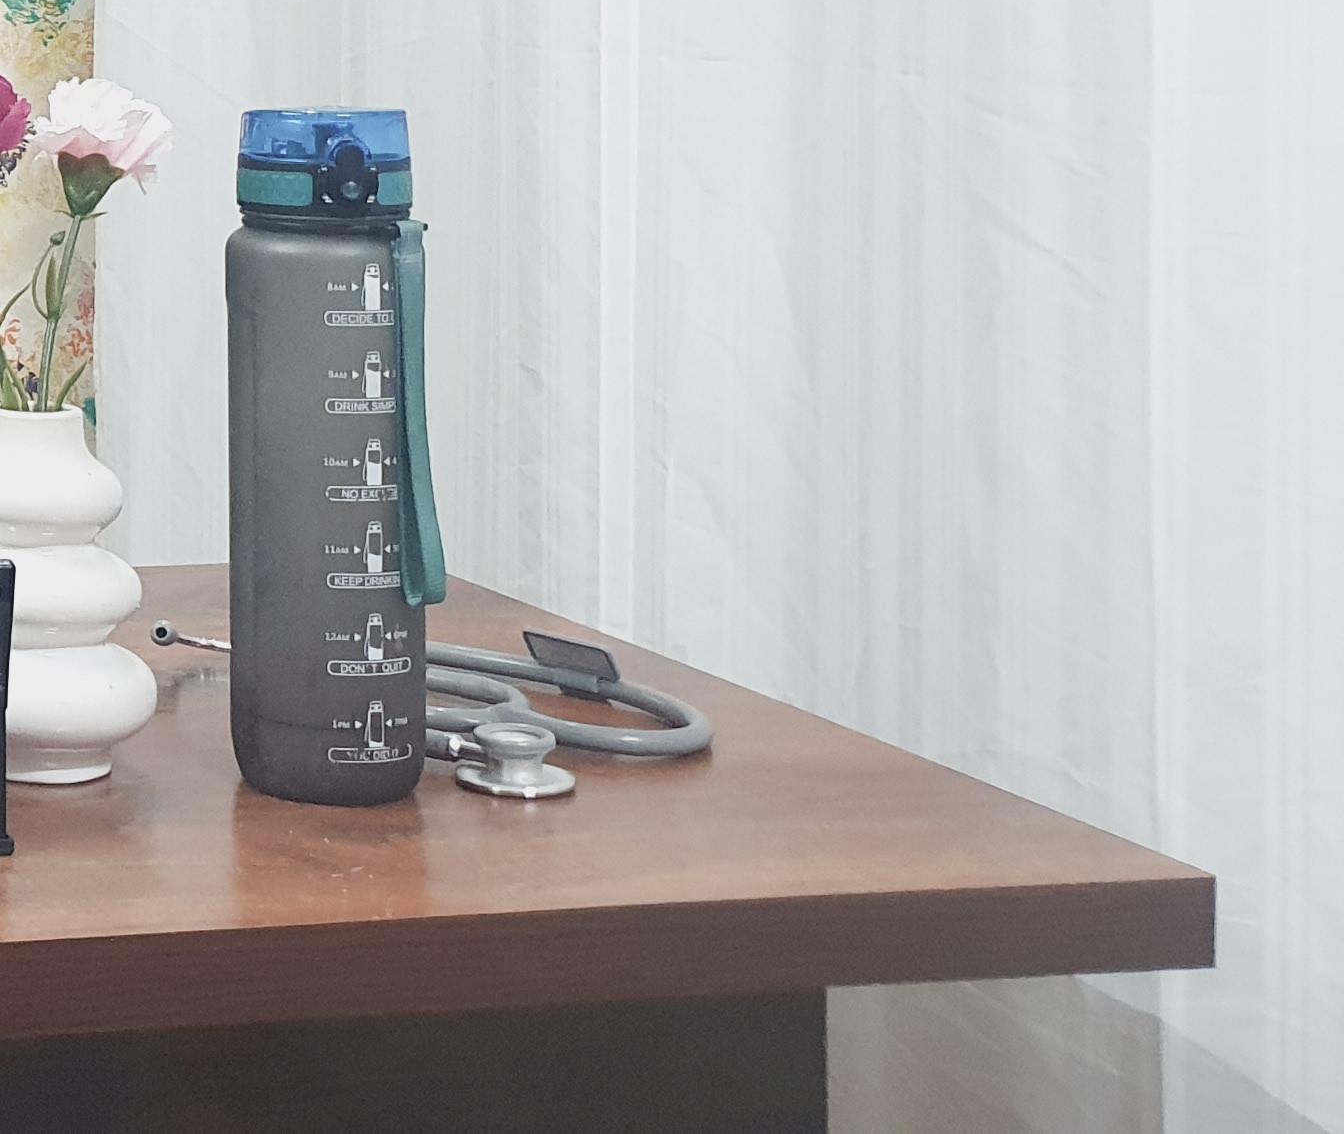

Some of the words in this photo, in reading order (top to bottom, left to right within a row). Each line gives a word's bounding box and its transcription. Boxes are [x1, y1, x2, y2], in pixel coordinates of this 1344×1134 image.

[332, 314, 374, 324] DECIDE
[376, 314, 389, 323] TO
[334, 401, 370, 412] DRINK
[341, 489, 359, 499] NO
[334, 576, 363, 586] KEEP
[382, 661, 404, 673] QUIT
